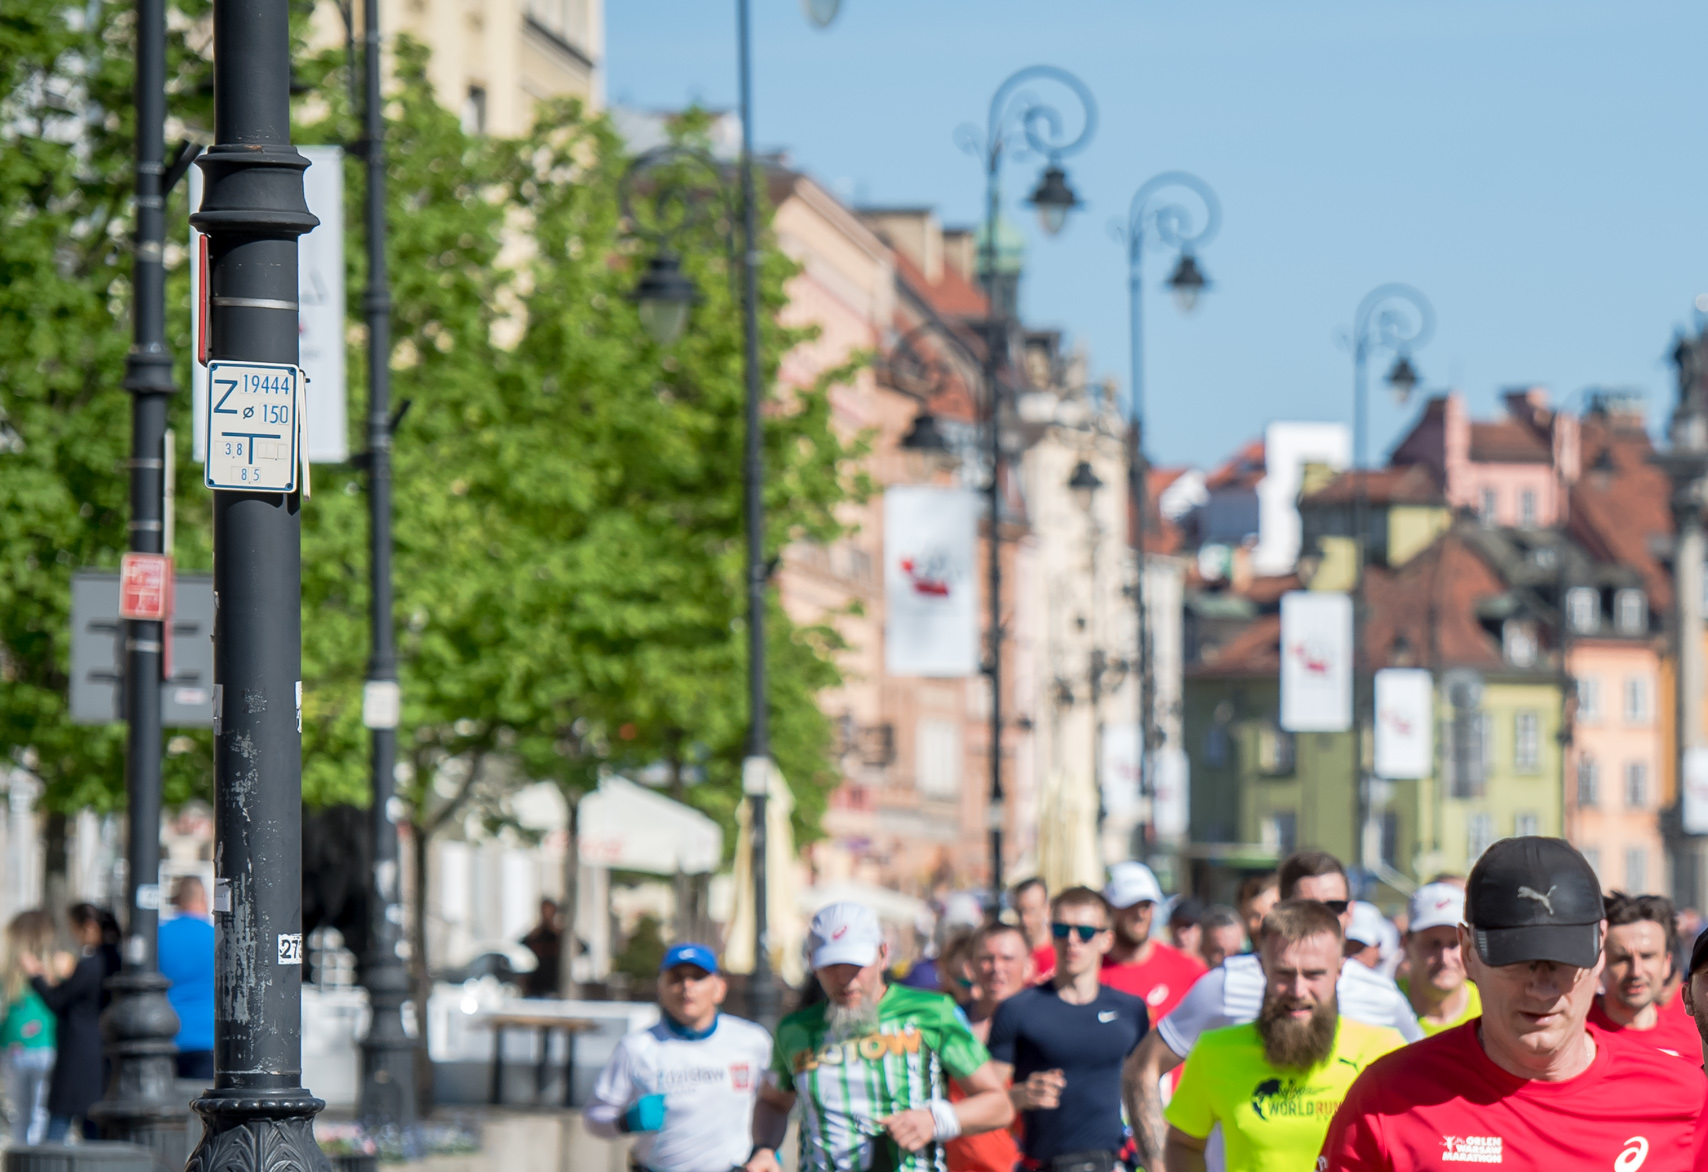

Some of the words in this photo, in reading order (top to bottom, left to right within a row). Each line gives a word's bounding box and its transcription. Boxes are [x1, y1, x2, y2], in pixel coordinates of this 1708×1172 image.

[243, 374, 289, 395] 19444
[213, 379, 238, 414] Z
[263, 404, 289, 424] 150
[1455, 1144, 1503, 1154] WARSAW
[1465, 1135, 1502, 1147] ORLEN
[1442, 1151, 1503, 1163] MARATHON
